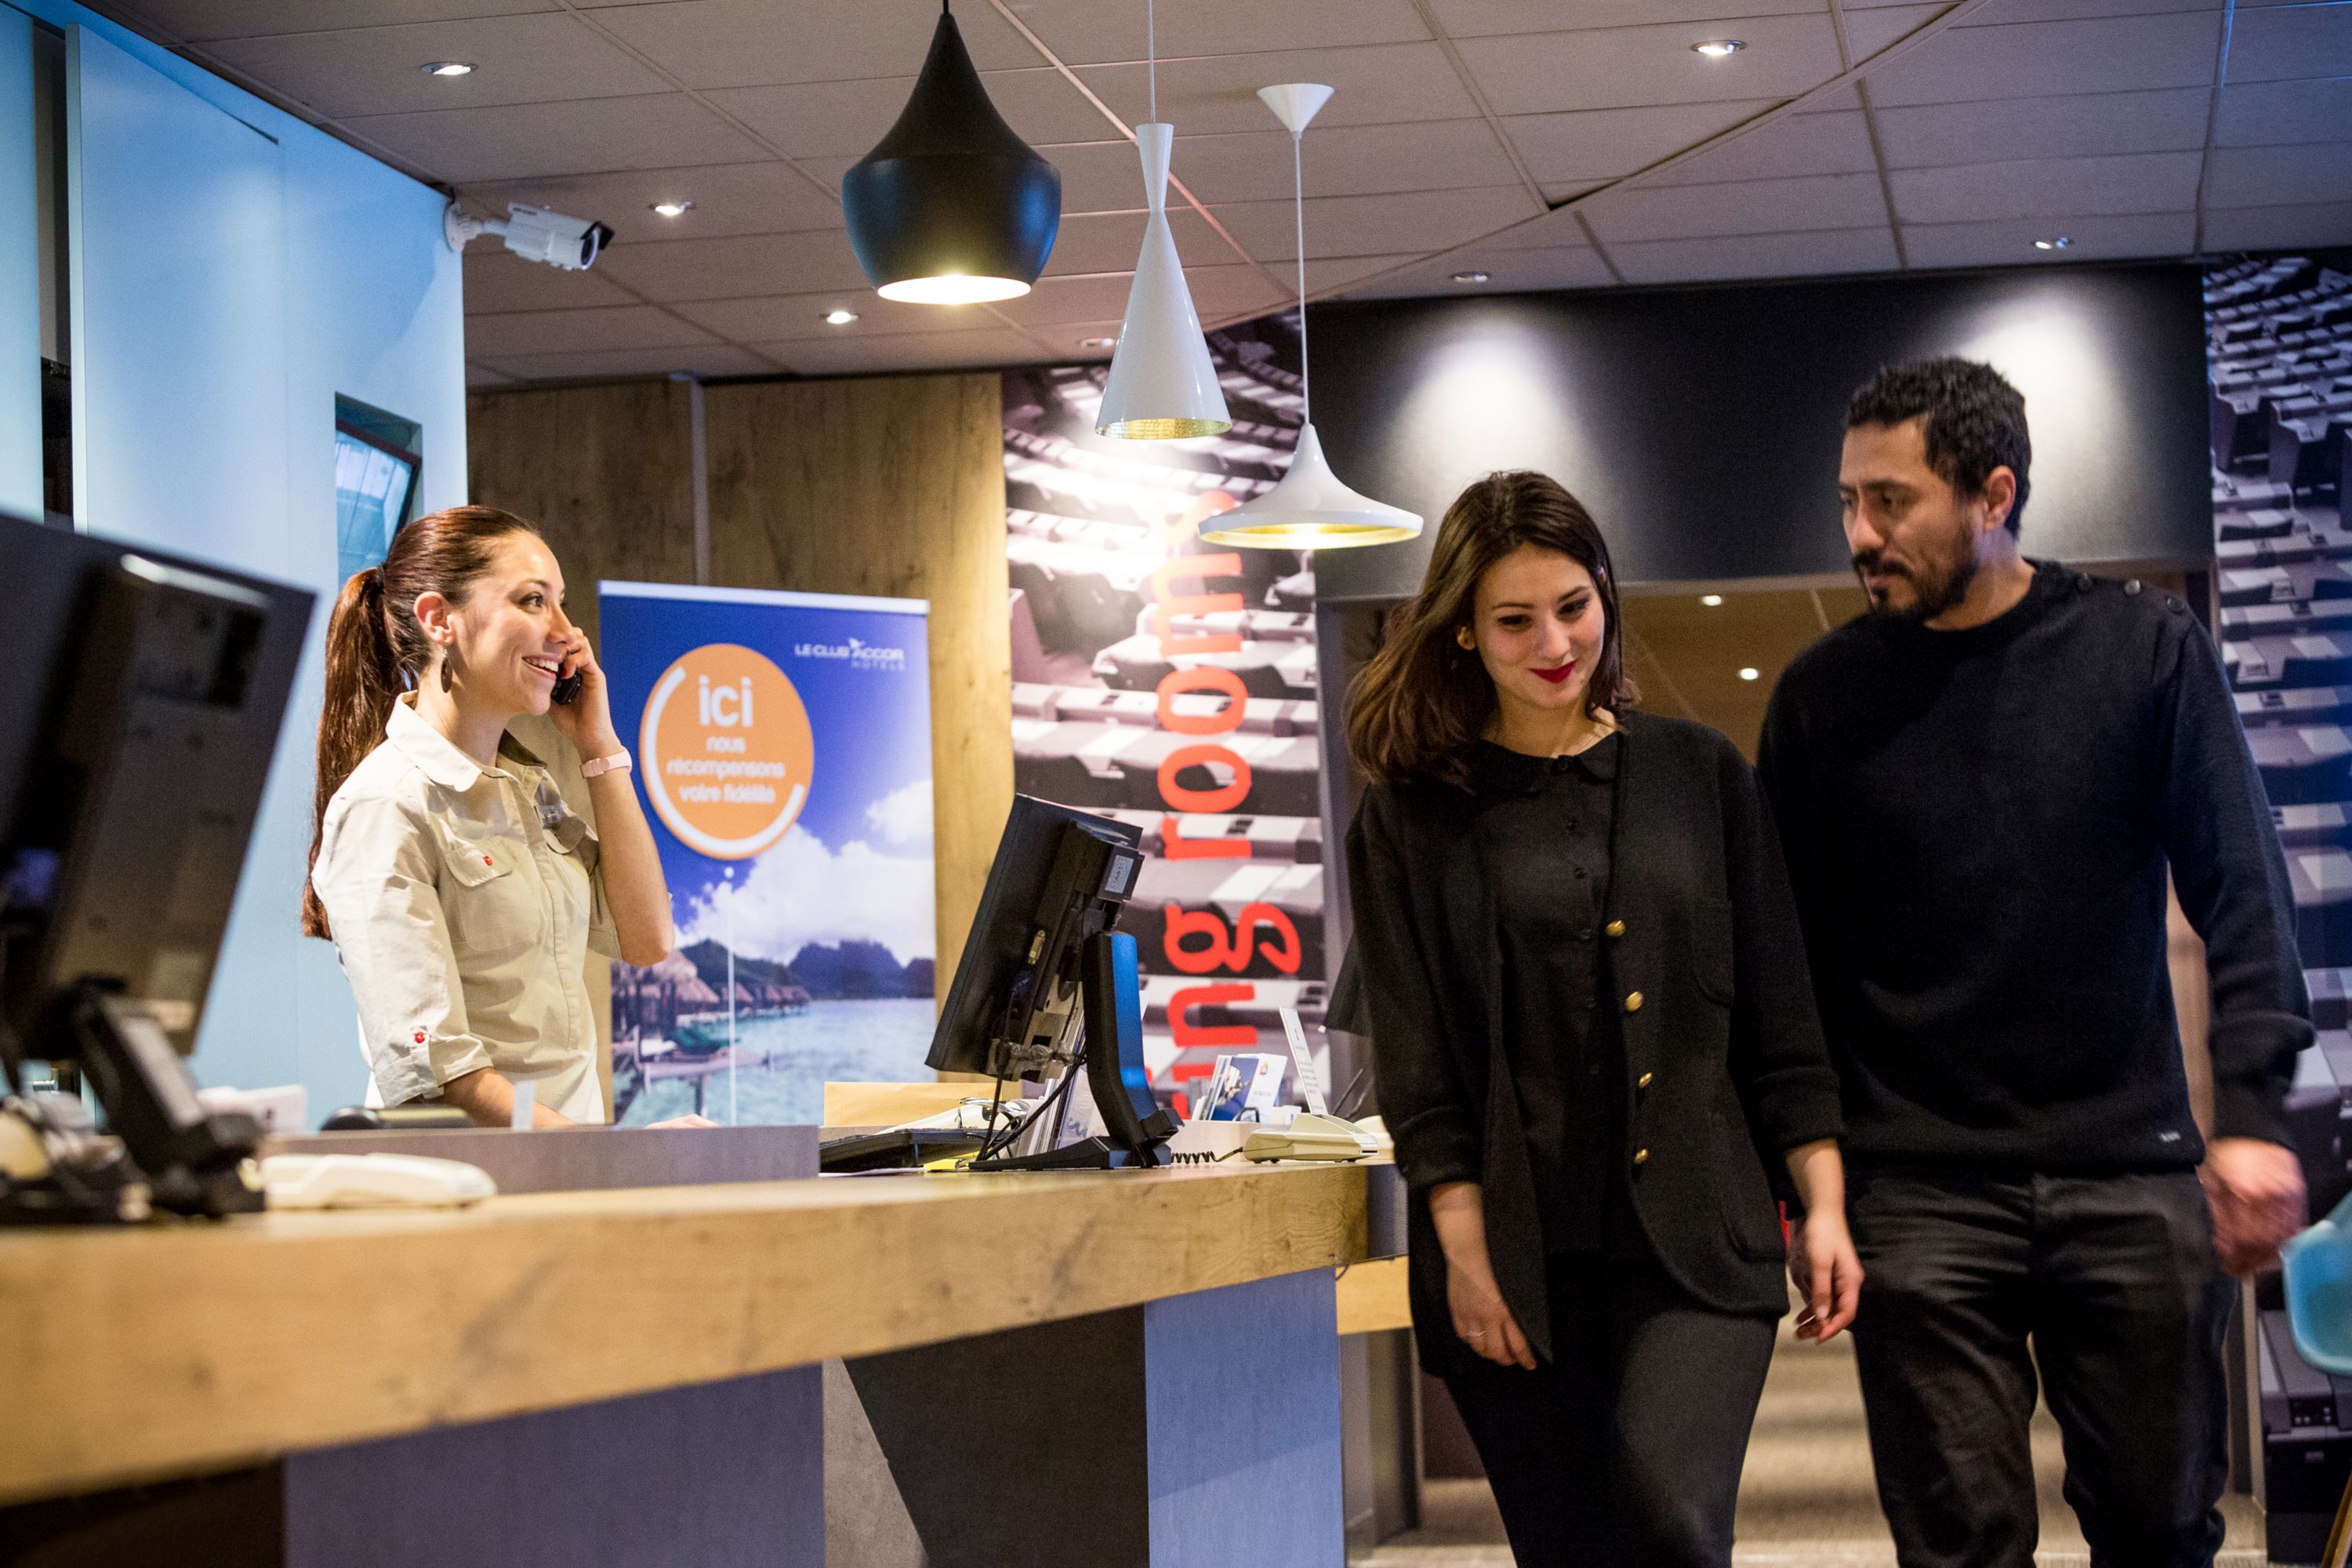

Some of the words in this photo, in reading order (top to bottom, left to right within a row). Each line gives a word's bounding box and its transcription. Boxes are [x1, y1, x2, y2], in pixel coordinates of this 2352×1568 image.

[794, 644, 812, 657] LE
[812, 644, 851, 659] CLUB
[851, 648, 905, 660] ACCOR
[699, 674, 753, 728] ici
[706, 736, 746, 753] nous
[679, 782, 721, 804] votre
